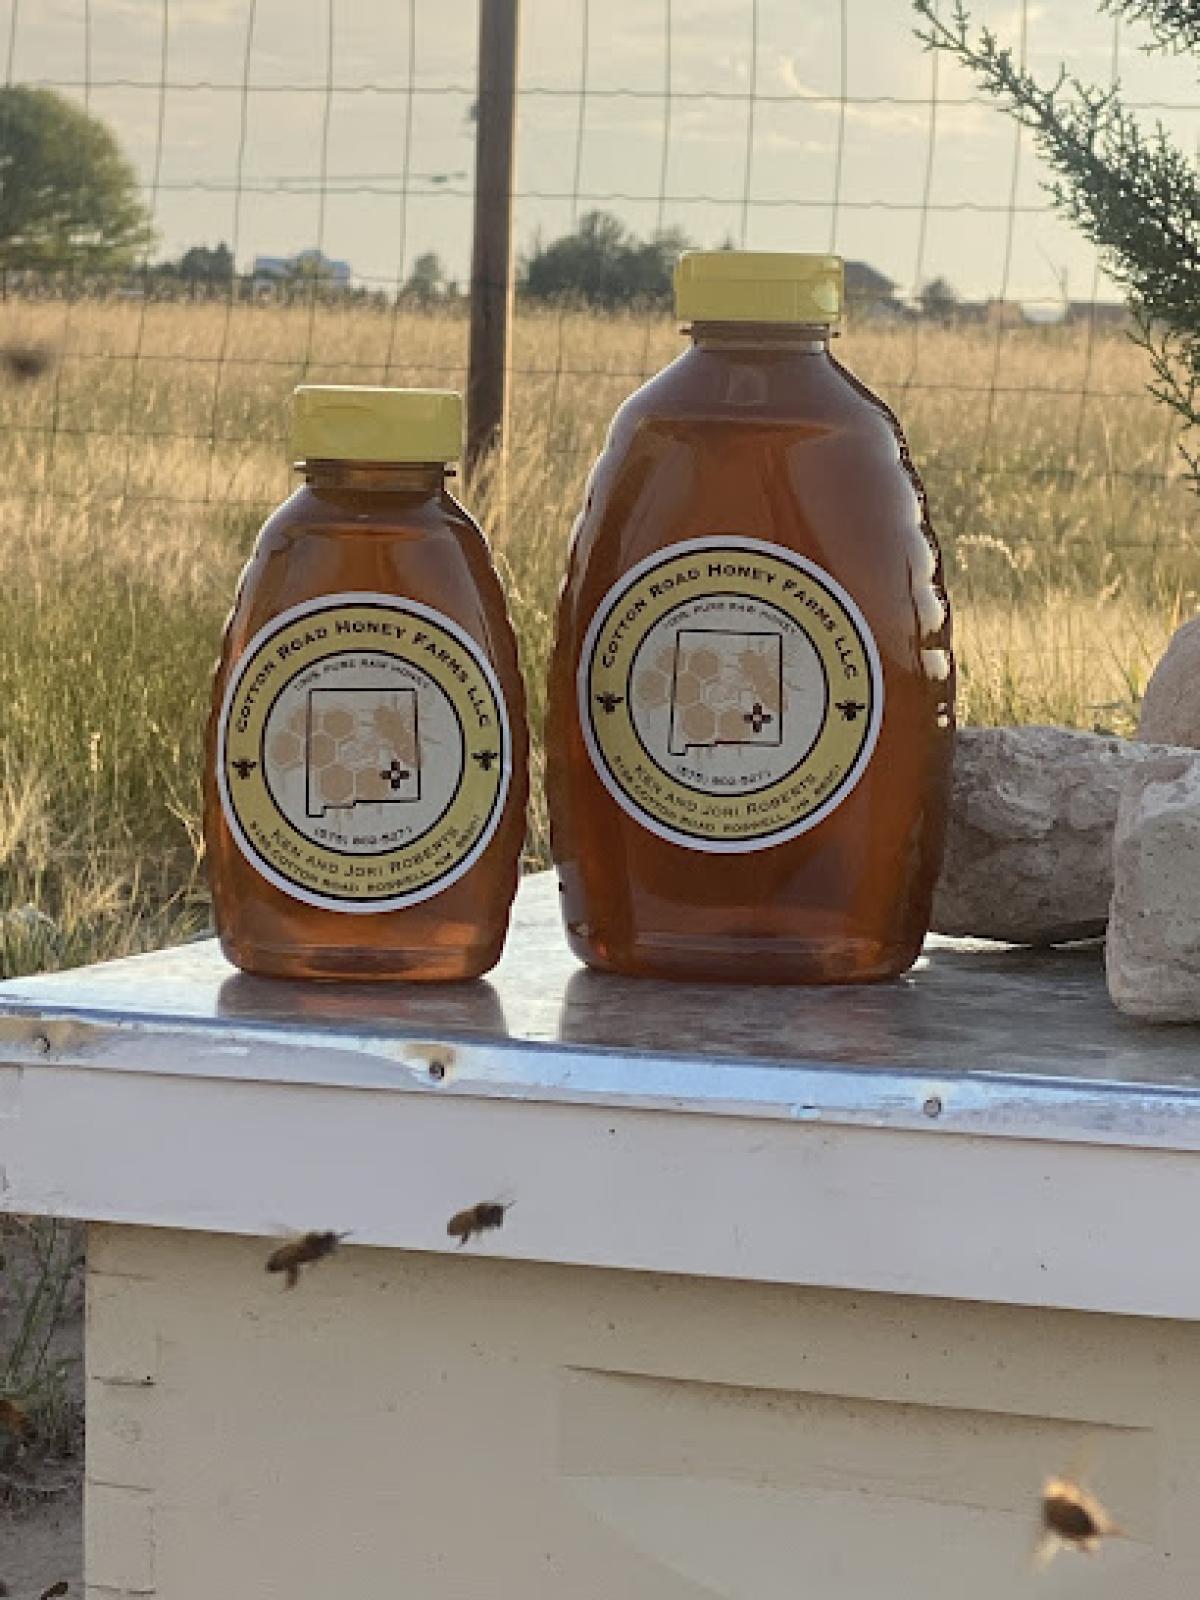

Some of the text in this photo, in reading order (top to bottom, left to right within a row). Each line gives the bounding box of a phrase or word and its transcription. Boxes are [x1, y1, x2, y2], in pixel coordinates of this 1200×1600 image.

[602, 563, 859, 680] COTTON ROAD HONEY FARMS LLC
[693, 602, 724, 615] PURE
[729, 602, 756, 613] RAW
[237, 620, 491, 733] COTTON ROAD HONEY FARMS LLC
[323, 658, 356, 674] PURE
[360, 658, 388, 669] RAW
[664, 793, 698, 812] AND
[746, 773, 816, 816] ROBERTS
[305, 856, 339, 874] AND
[390, 827, 459, 874] ROBERTS
